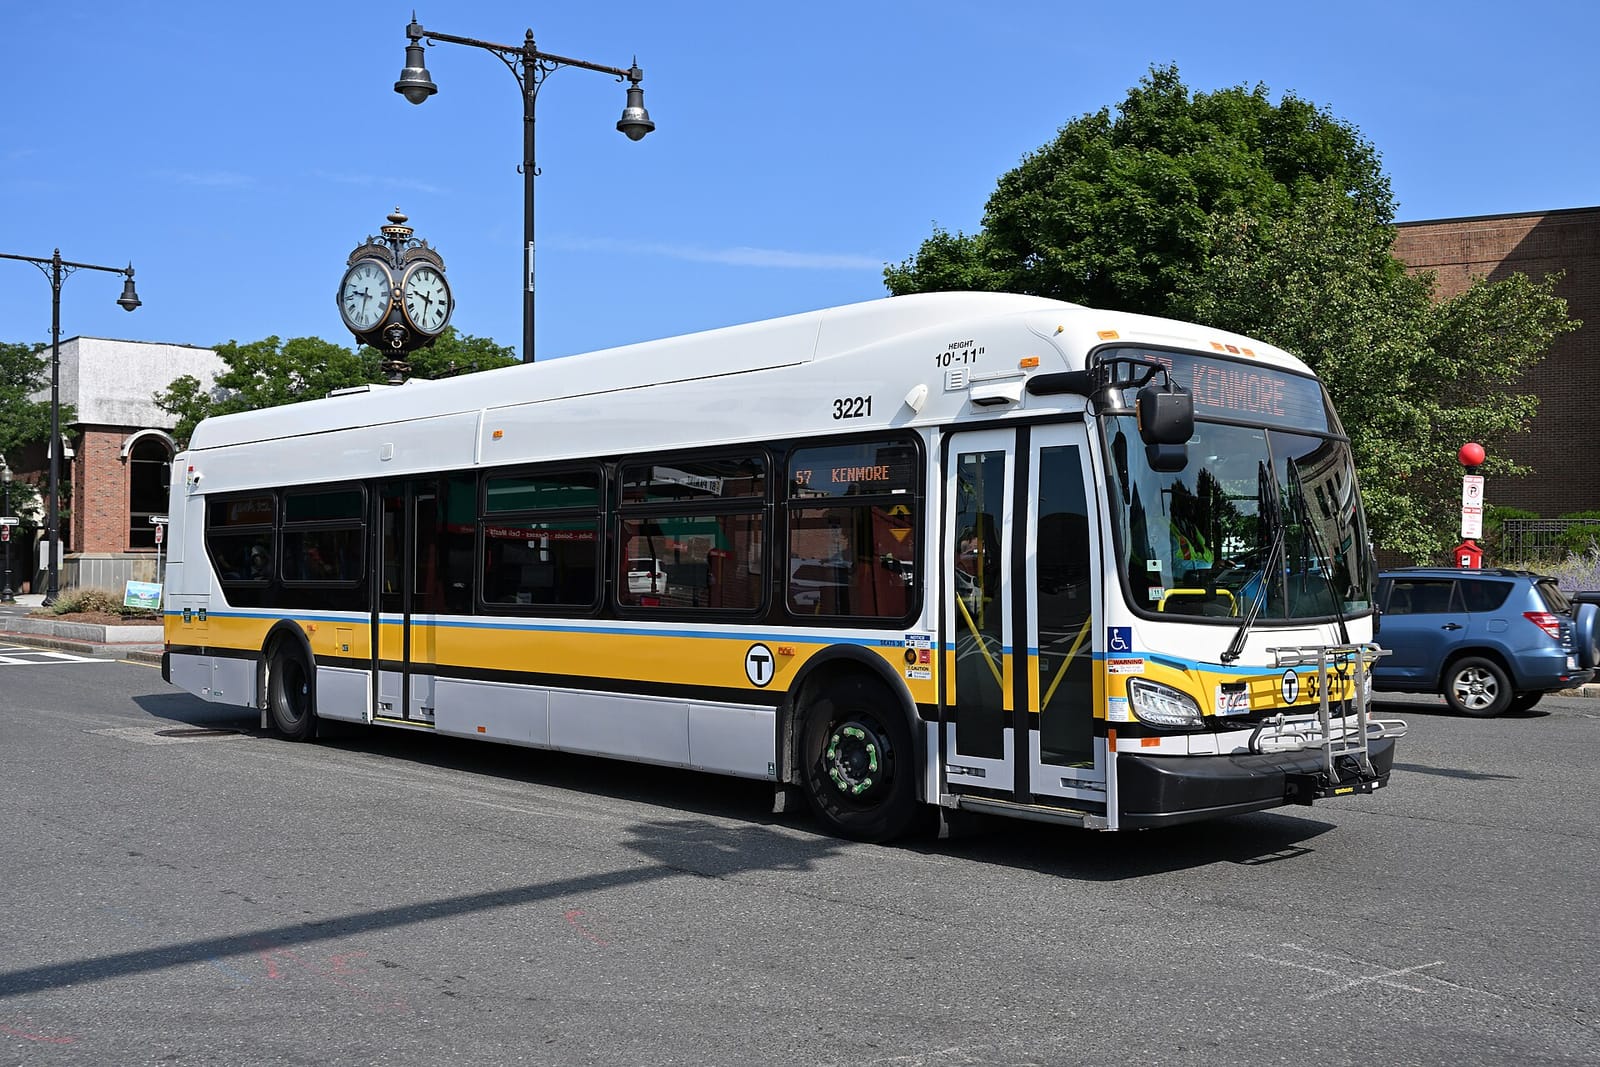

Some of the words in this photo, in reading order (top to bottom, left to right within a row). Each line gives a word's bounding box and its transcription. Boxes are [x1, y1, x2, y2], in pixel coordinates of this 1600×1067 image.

[948, 340, 974, 351] HEIGHT
[935, 347, 985, 368] 10'-11"
[1192, 363, 1286, 416] KENMORE
[832, 395, 873, 420] 3221
[795, 470, 812, 485] 57
[831, 465, 891, 483] KENMORE
